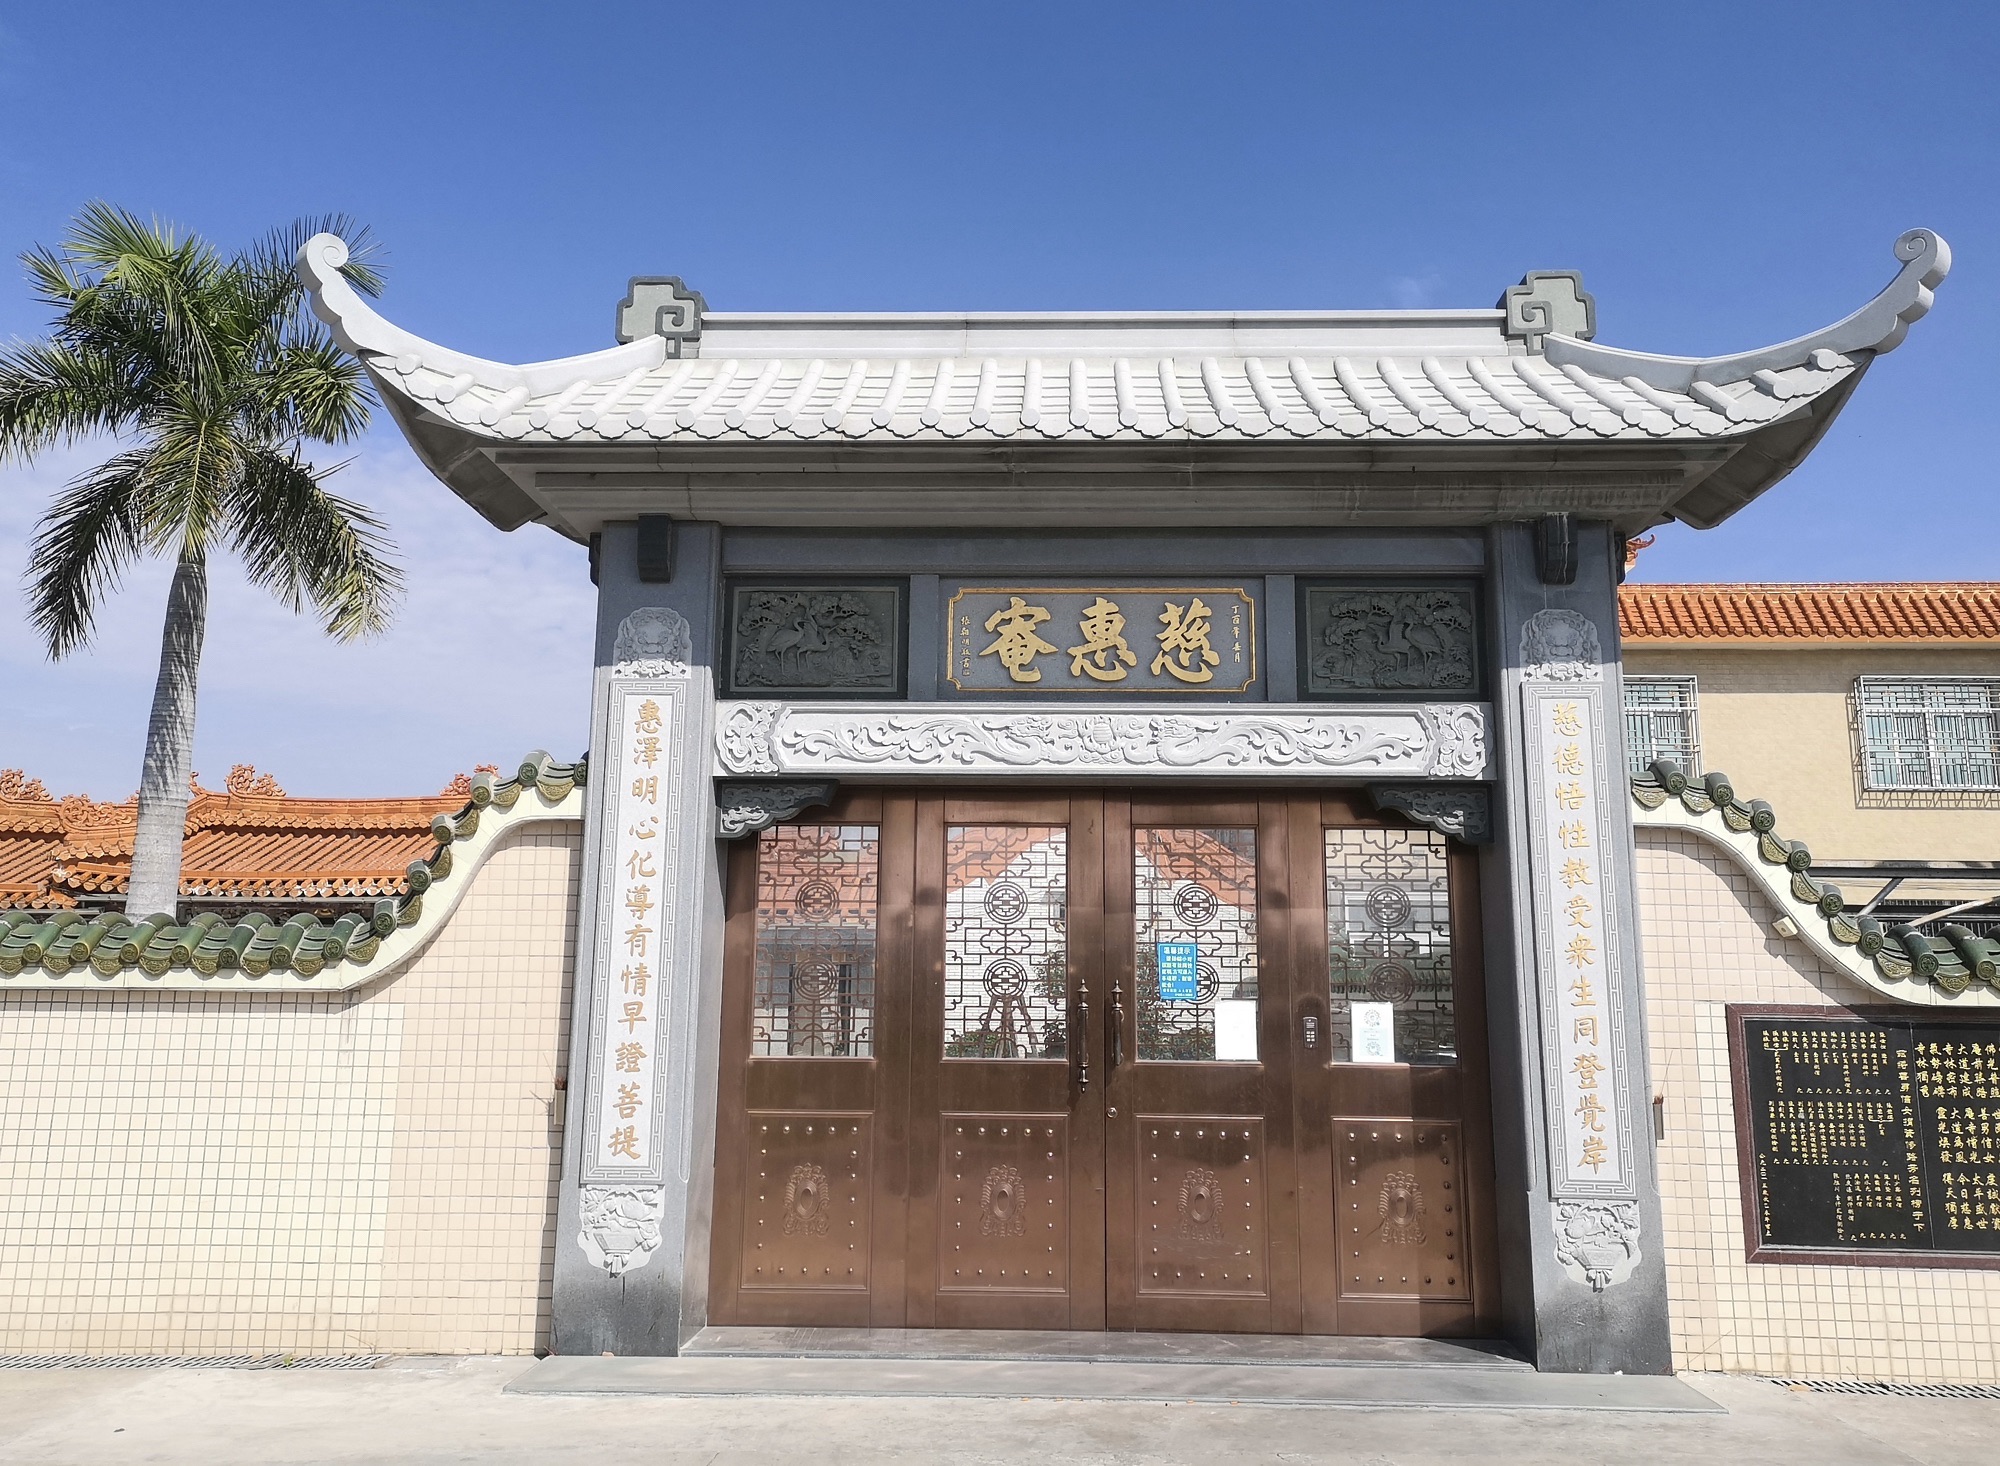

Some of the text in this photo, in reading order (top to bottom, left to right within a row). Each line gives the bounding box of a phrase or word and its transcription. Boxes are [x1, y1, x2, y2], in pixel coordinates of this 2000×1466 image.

[608, 699, 663, 1161] 惠澤明心化導有情早證菩提
[1957, 1043, 1974, 1099] 大道建成
[1977, 1107, 1995, 1163] 善男信女
[1972, 1173, 1989, 1230] 太平盛世
